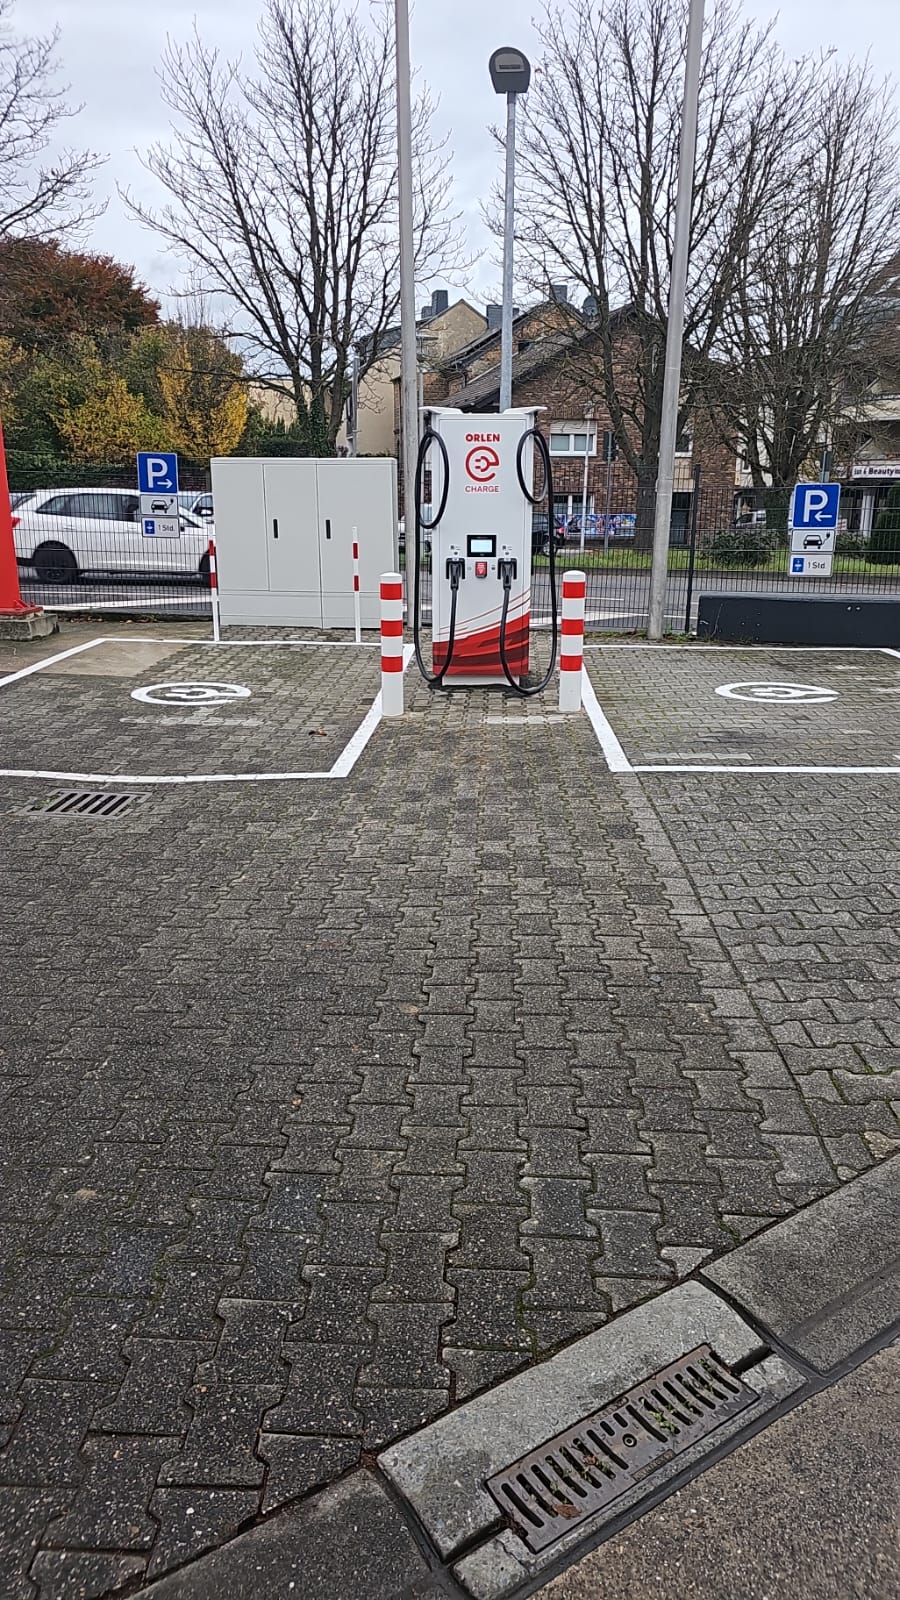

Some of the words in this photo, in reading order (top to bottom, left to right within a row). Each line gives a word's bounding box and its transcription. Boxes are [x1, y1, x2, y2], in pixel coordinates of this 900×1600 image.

[465, 433, 500, 442] ORLEN
[146, 458, 168, 488] P
[465, 485, 500, 493] CHARGE
[803, 490, 829, 523] P
